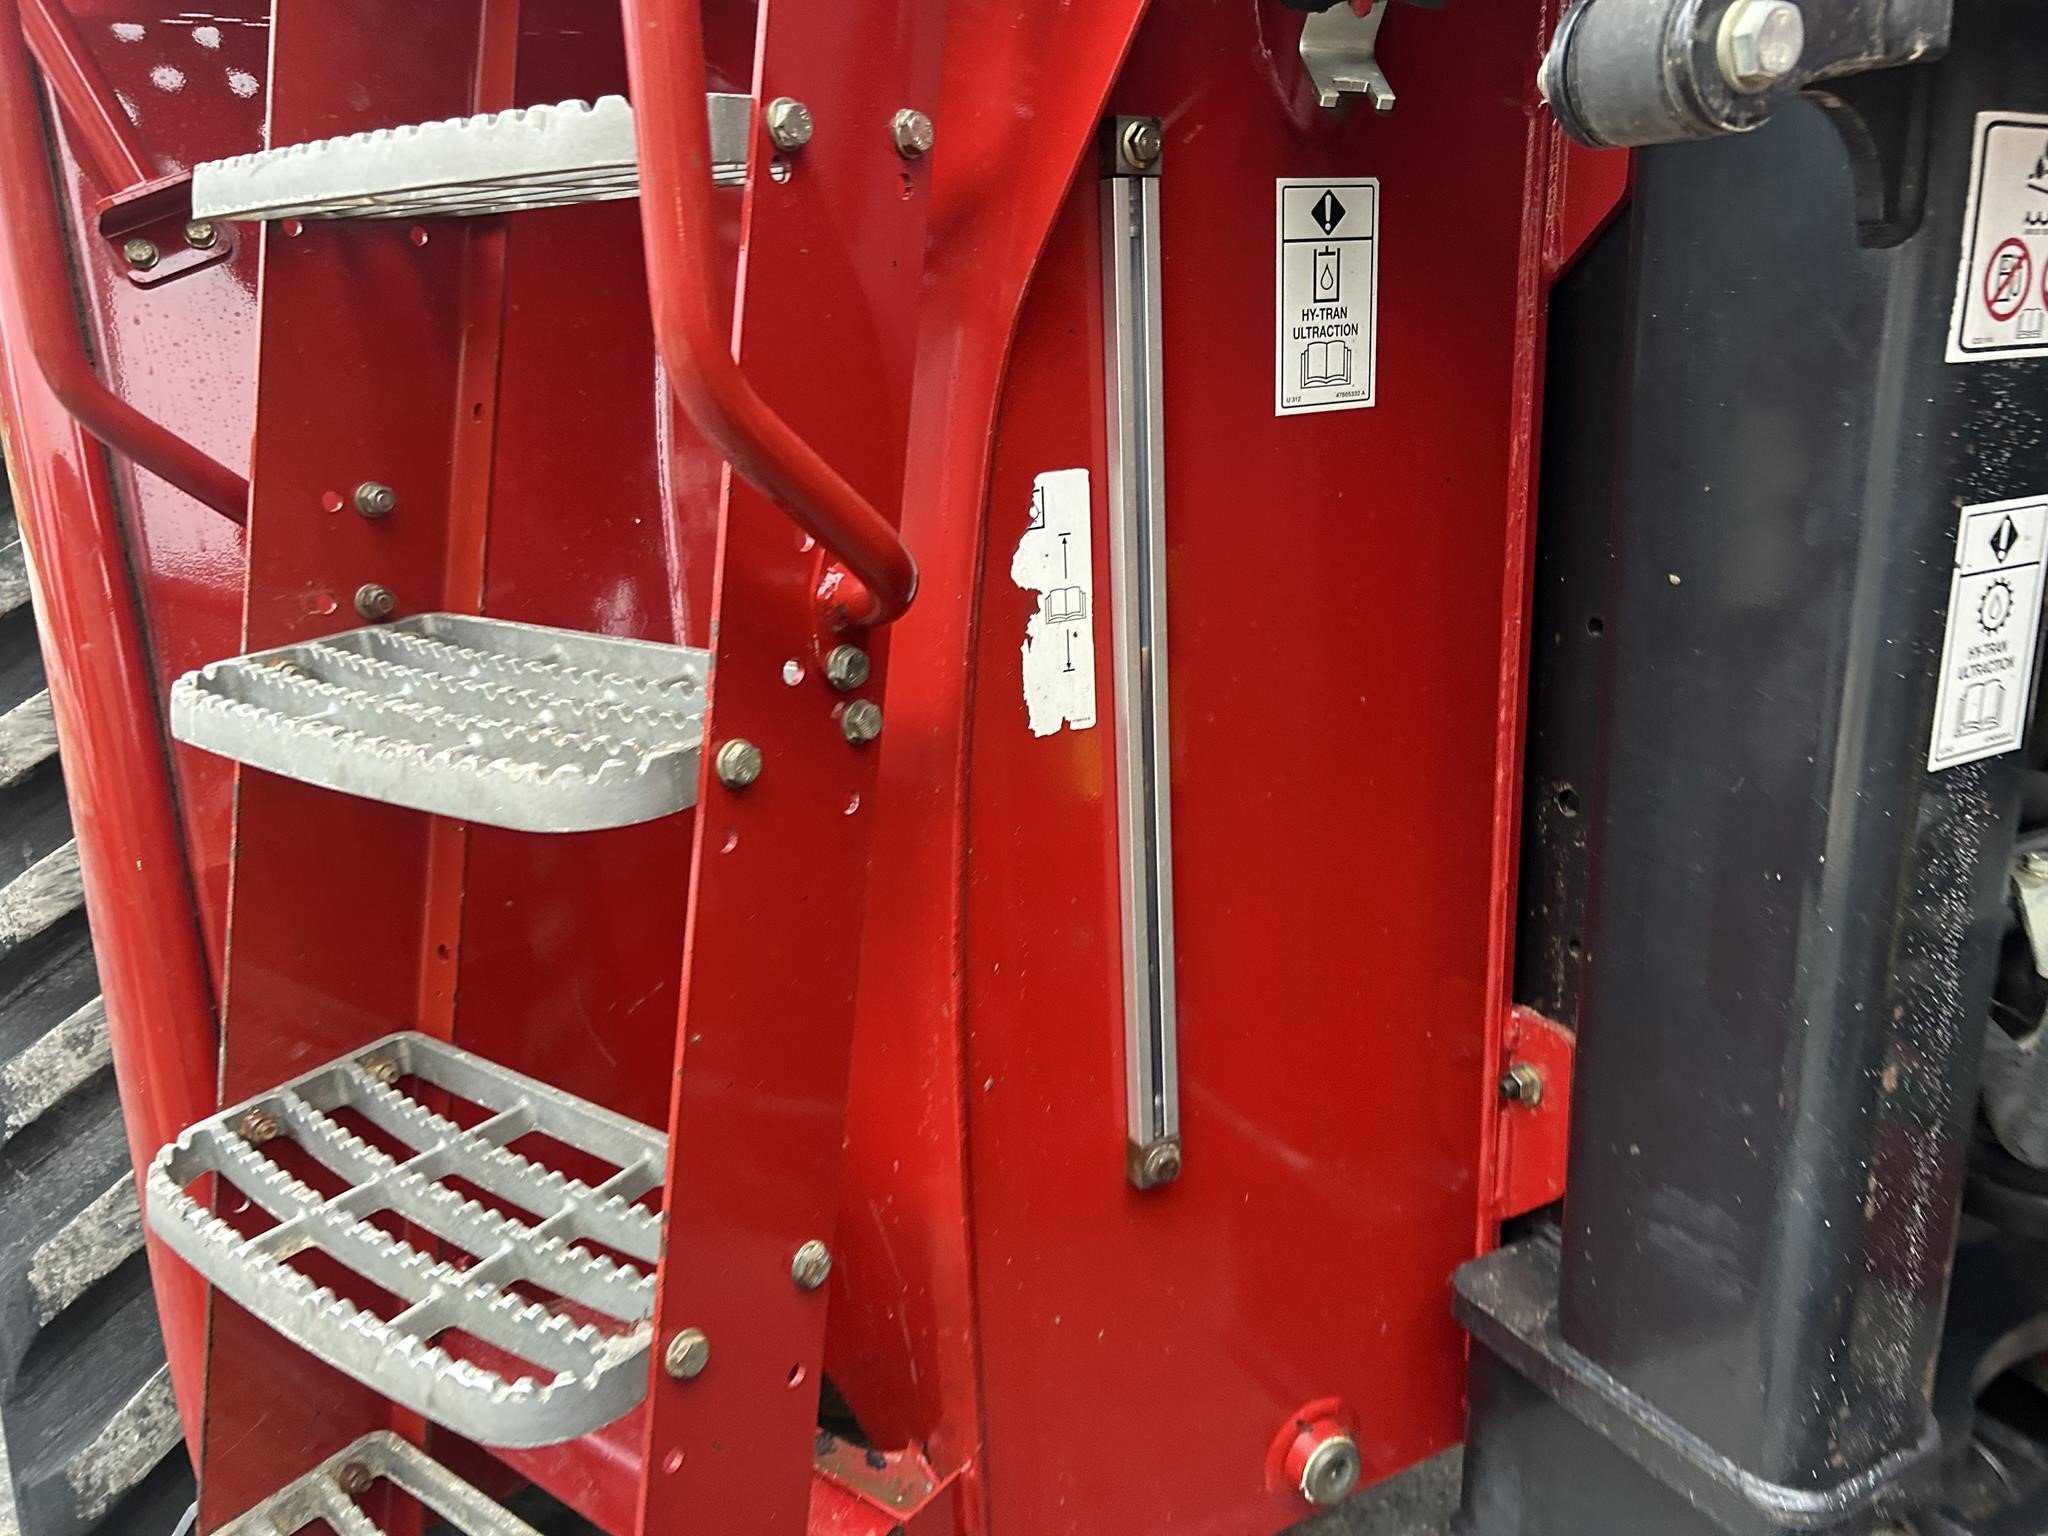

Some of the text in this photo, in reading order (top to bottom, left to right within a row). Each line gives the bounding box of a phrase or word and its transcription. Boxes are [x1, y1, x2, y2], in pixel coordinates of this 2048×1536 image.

[1302, 306, 1348, 321] HY-TRAN
[1293, 323, 1359, 340] ULTRACTION
[1957, 656, 2015, 680] ULTRACTION
